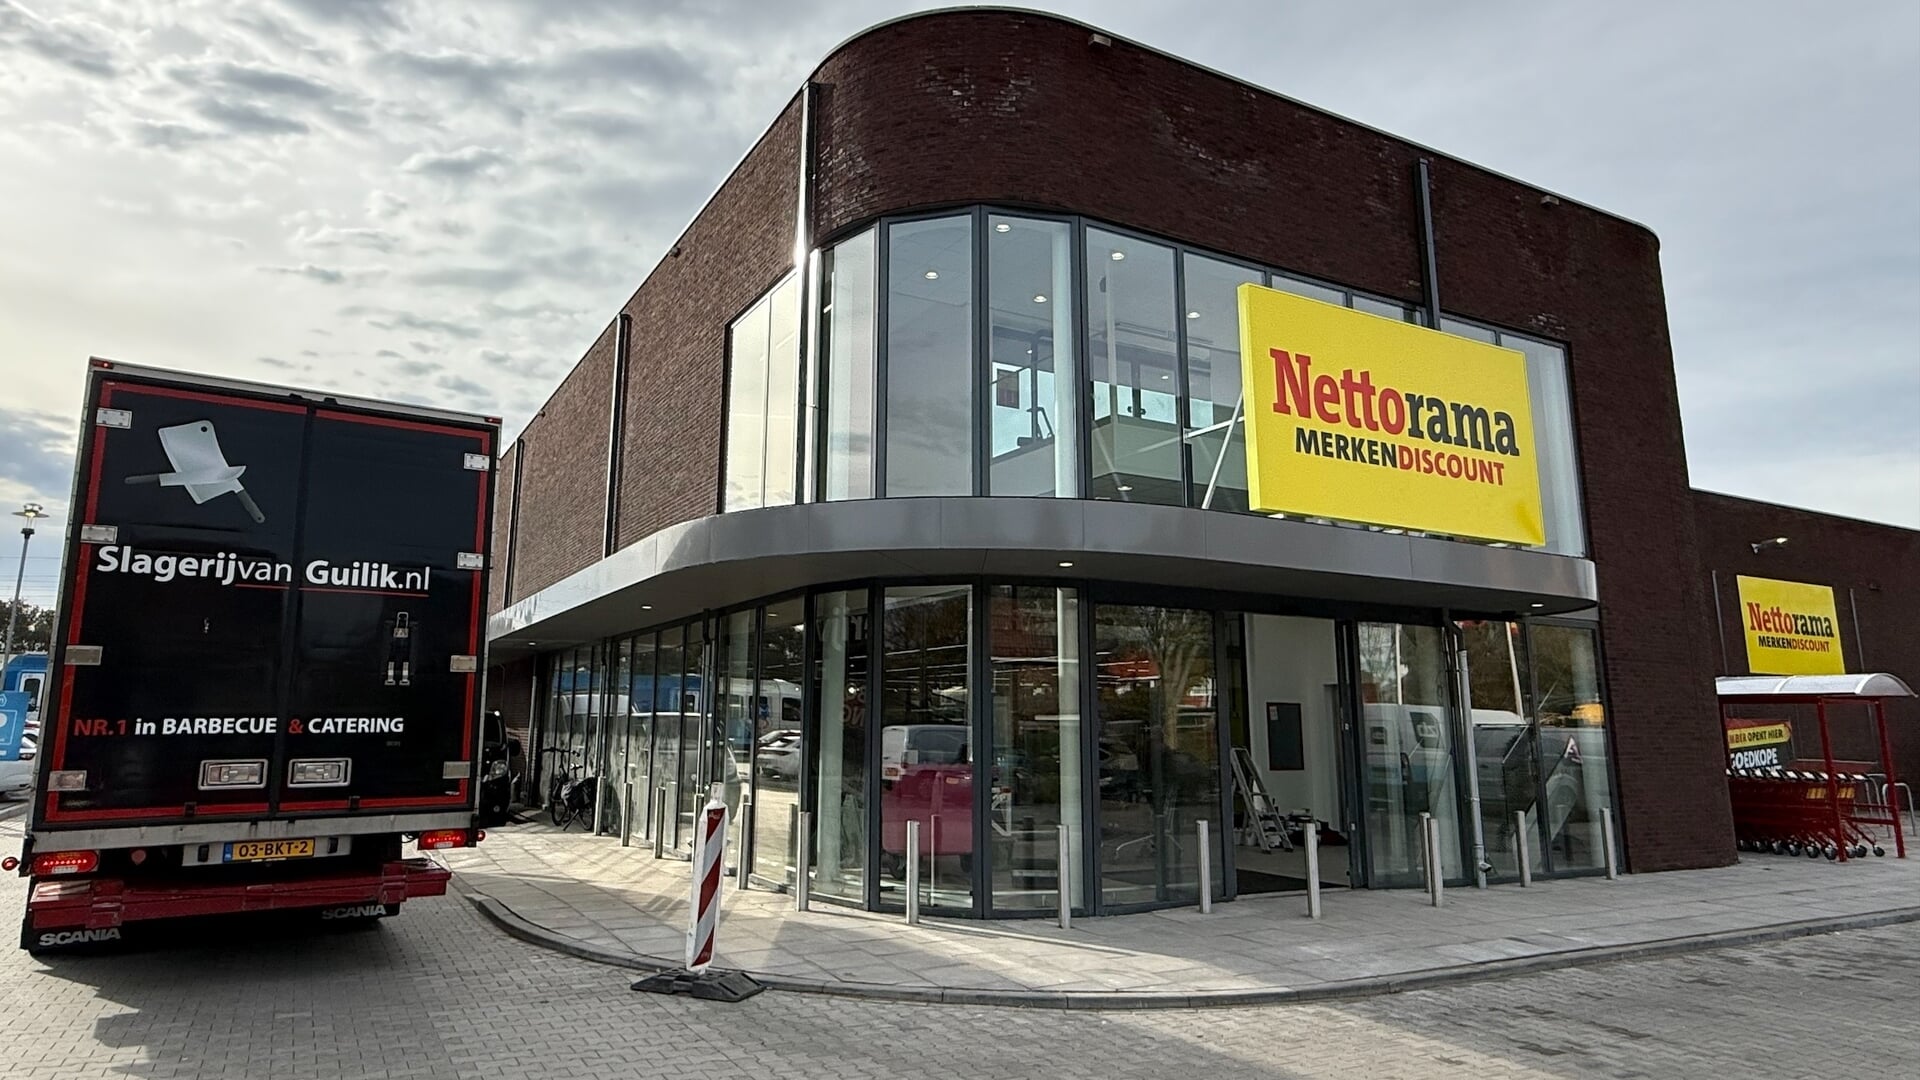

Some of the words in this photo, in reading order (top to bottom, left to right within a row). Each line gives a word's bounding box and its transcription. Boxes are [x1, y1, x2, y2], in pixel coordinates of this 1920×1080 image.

[1269, 347, 1520, 457] Nettorama
[1295, 427, 1504, 486] MERKENDISCOUNT
[305, 559, 430, 591] Guilik.nl
[1747, 602, 1834, 637] Nettorama
[1758, 635, 1830, 653] MERKENDISCOUNT
[134, 717, 156, 735] in
[162, 717, 277, 735] BARBECUE
[288, 718, 303, 734] &
[308, 717, 404, 734] CATERING
[238, 840, 308, 857] 03-BKT-2
[321, 904, 387, 920] SCANIA
[38, 927, 121, 946] SCANIA
